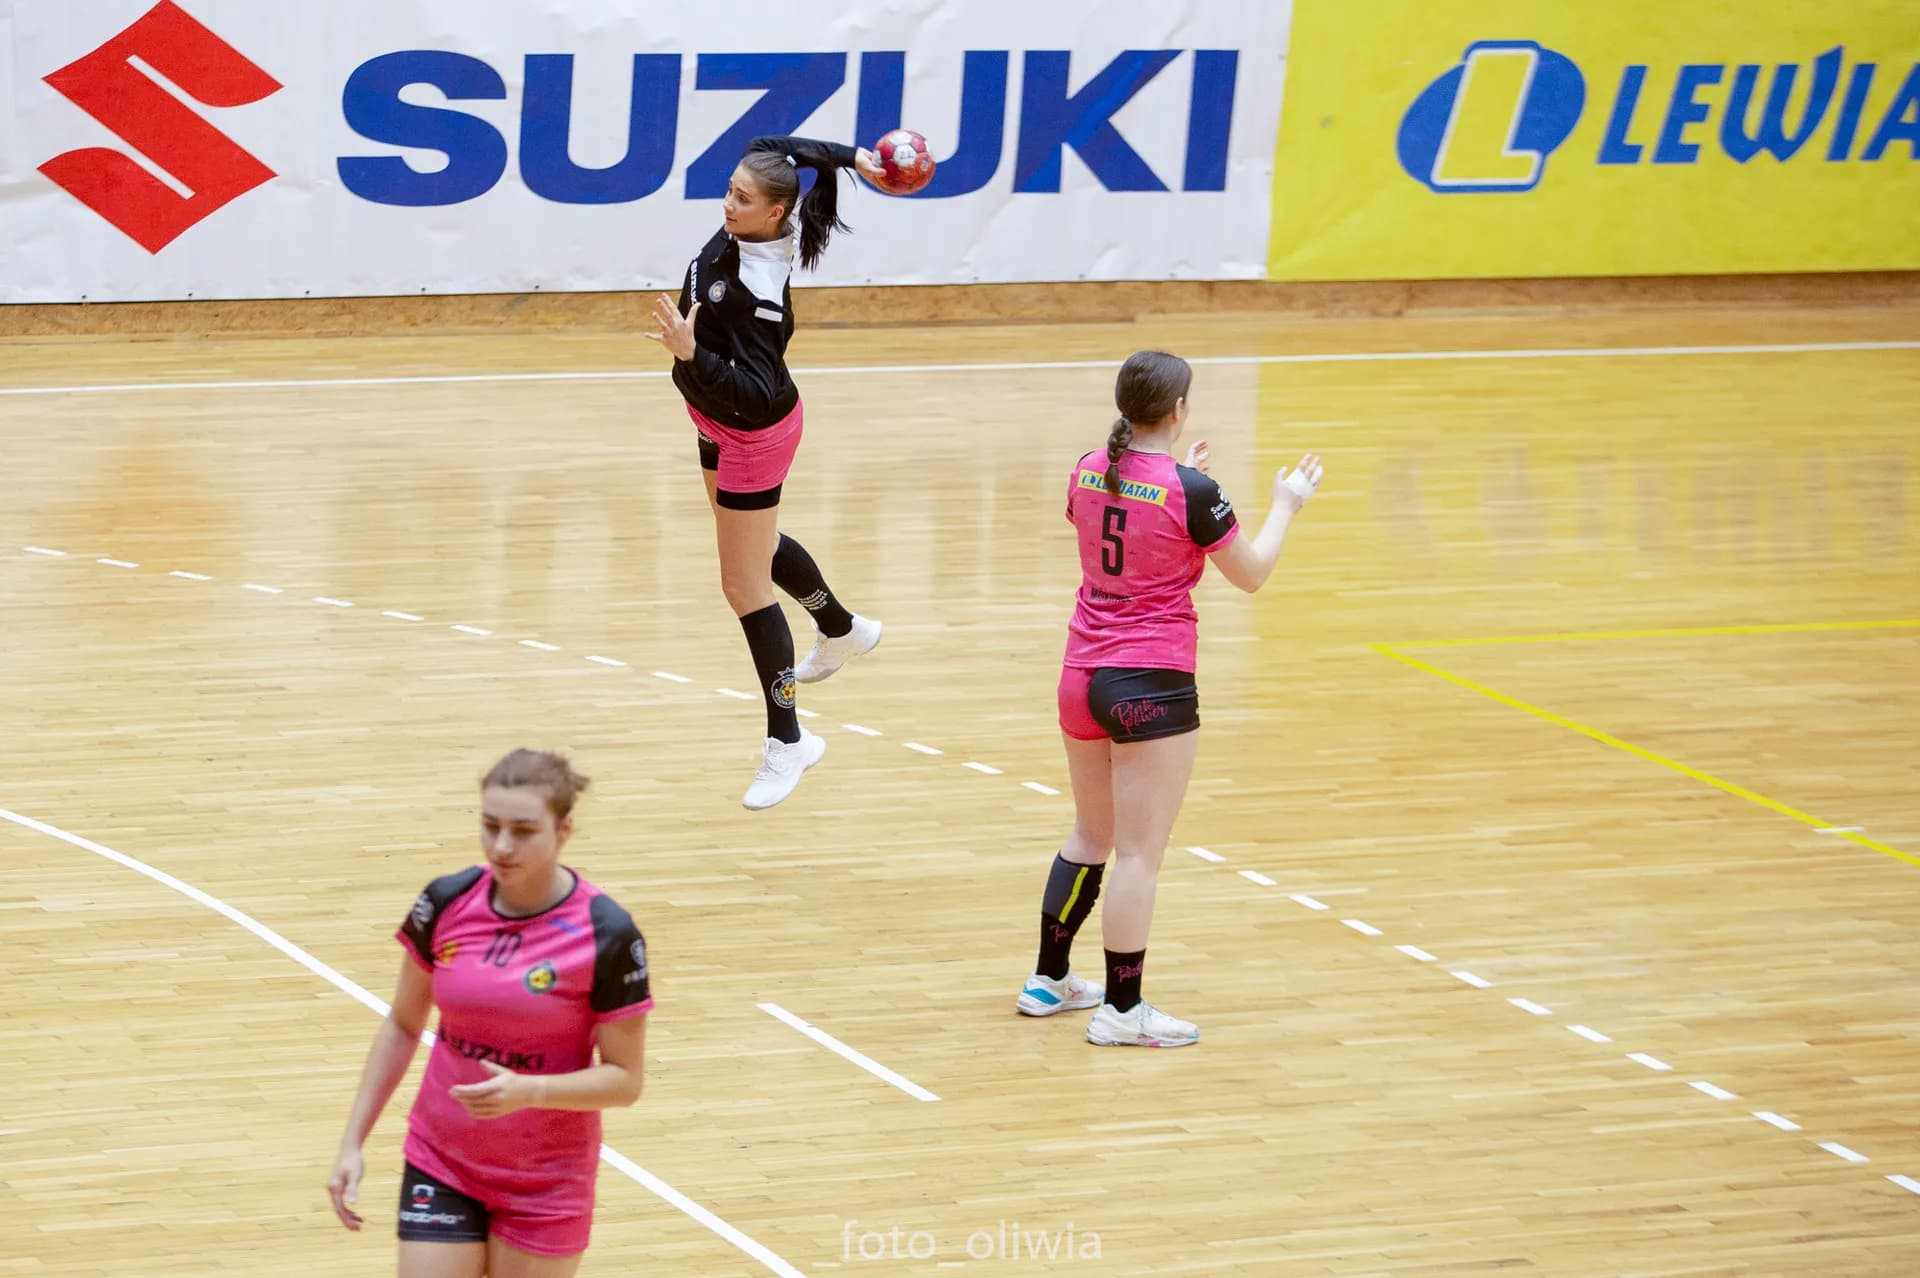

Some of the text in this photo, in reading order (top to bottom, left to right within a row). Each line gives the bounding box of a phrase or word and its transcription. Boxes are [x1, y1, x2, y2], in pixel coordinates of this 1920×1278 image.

[336, 49, 1240, 207] SUZUKI
[1101, 505, 1128, 576] 5
[483, 930, 523, 968] 10
